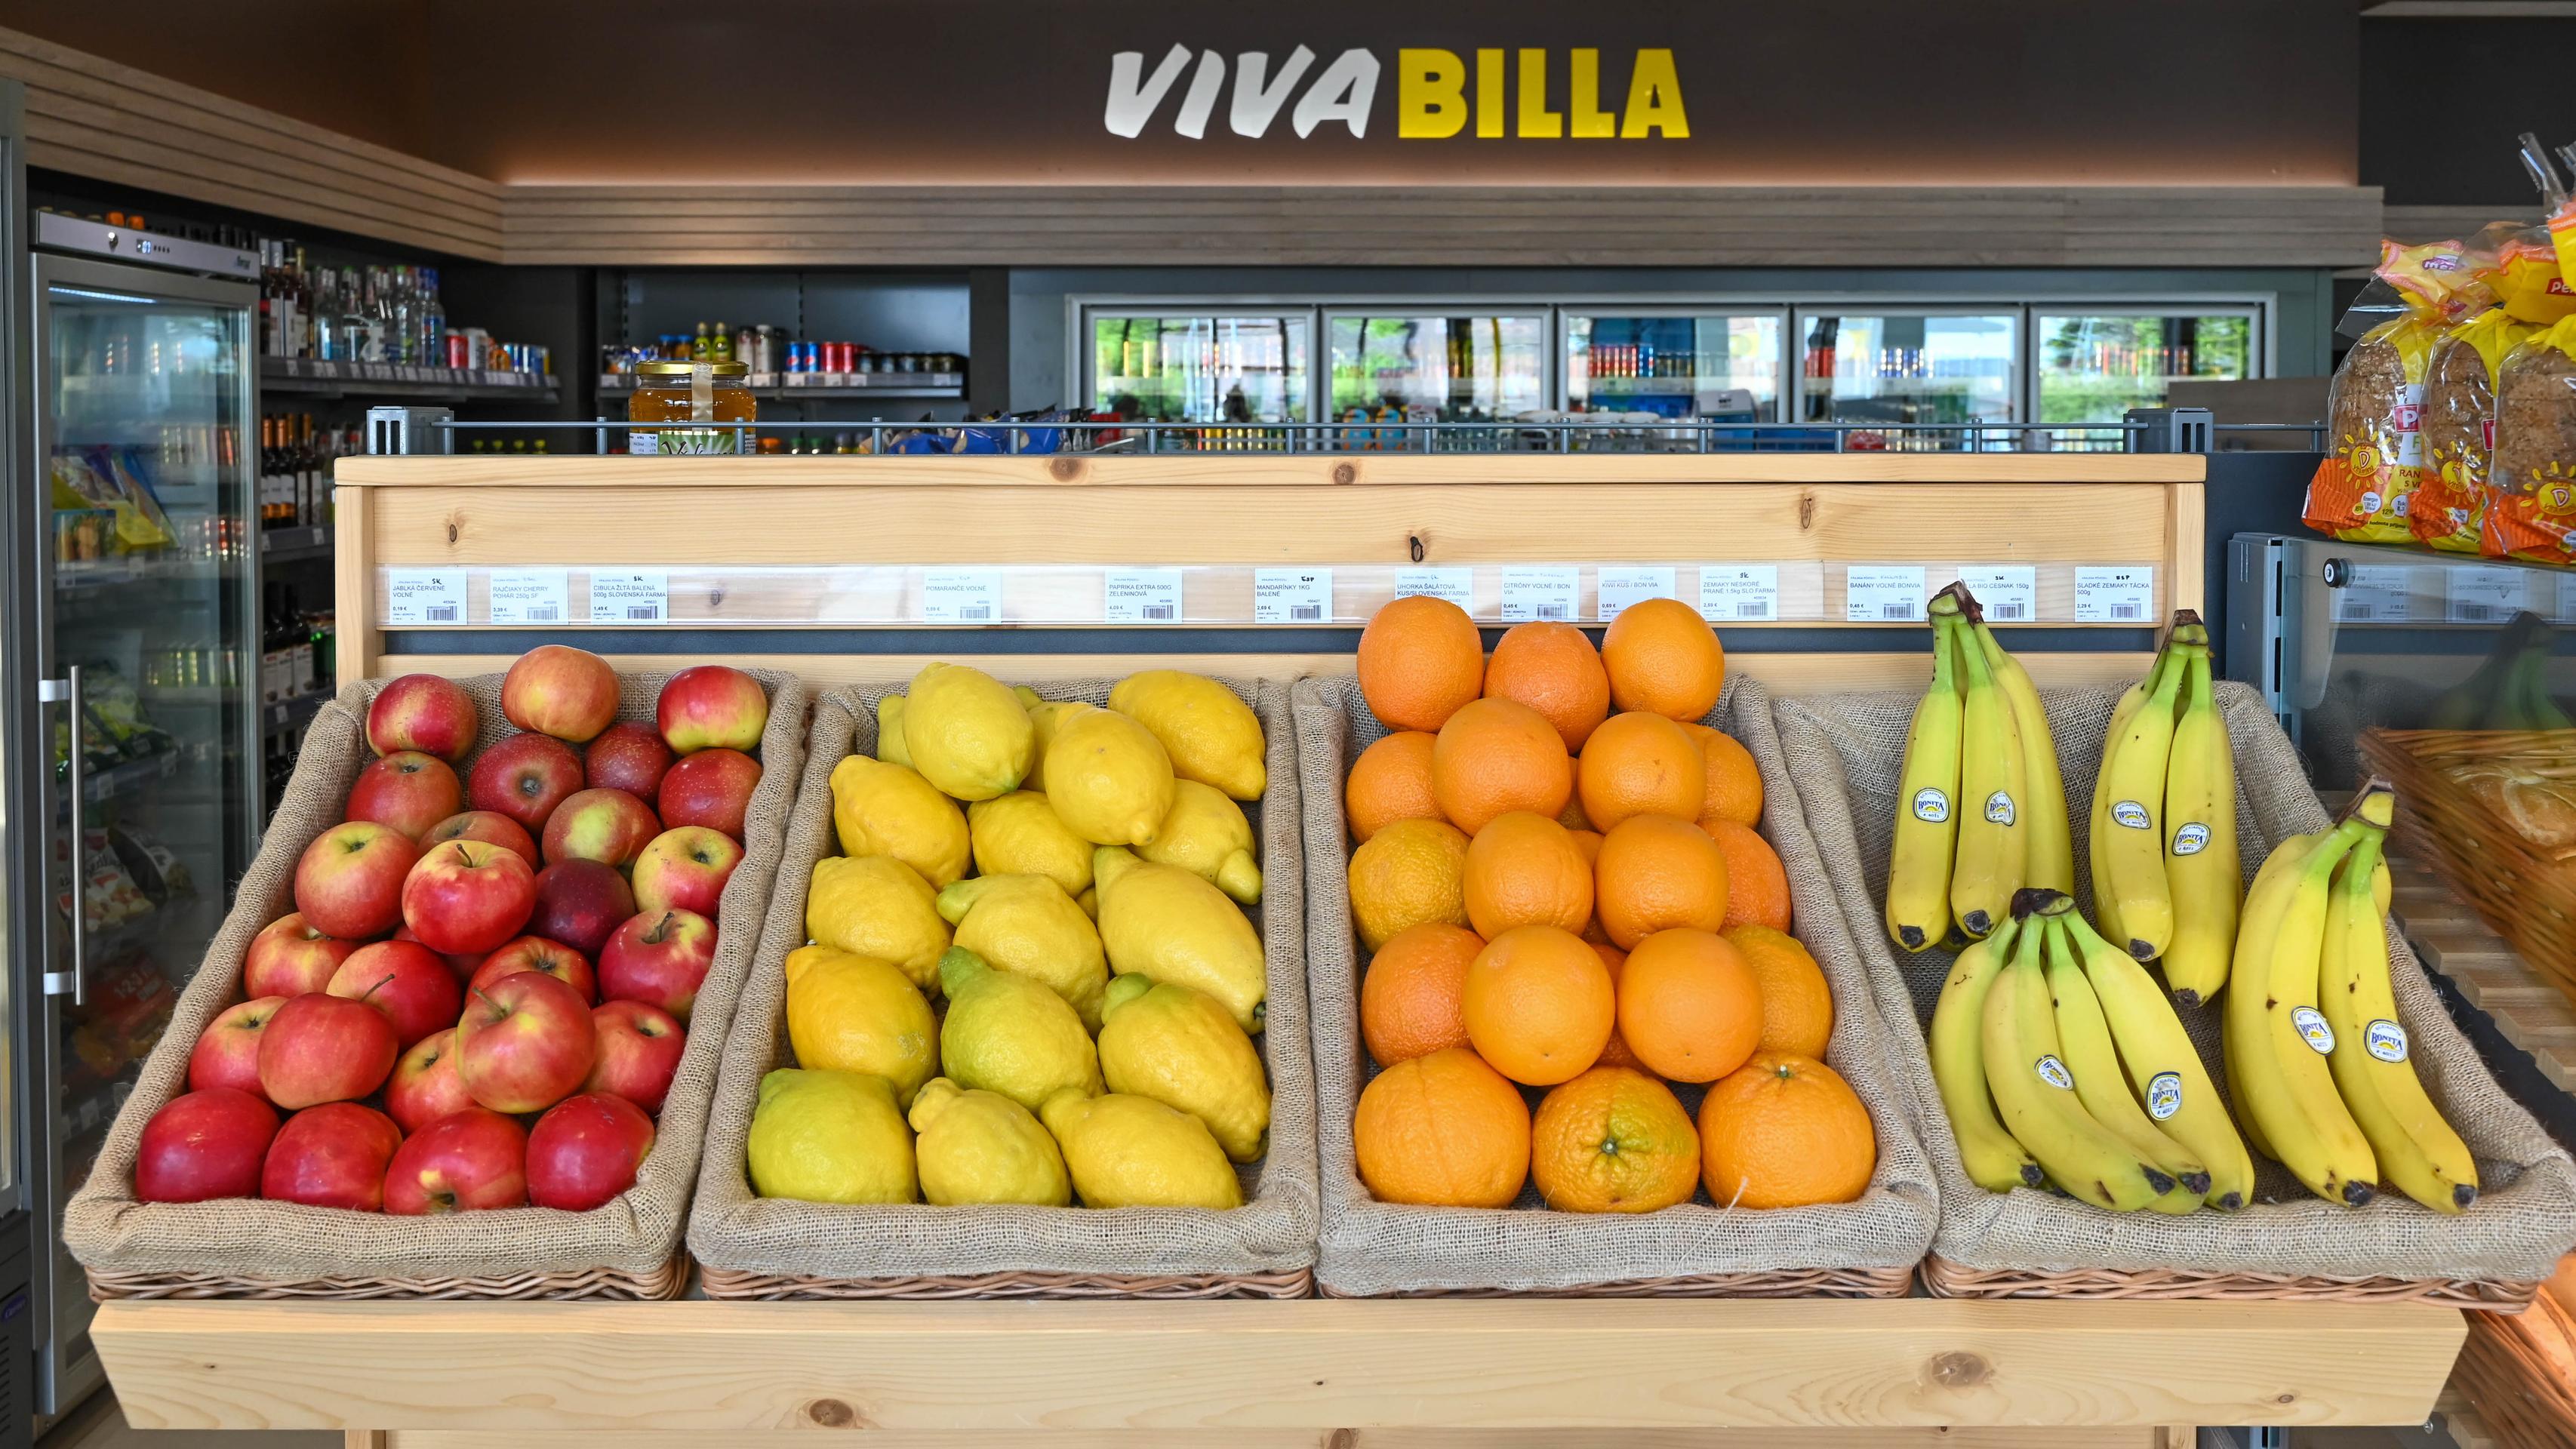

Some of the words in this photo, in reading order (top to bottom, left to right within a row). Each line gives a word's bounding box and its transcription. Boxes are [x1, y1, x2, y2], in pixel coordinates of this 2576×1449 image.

[1104, 42, 1381, 139] VIVA
[1398, 48, 1691, 138] BILLA
[2399, 469, 2421, 478] RAN
[1918, 800, 1945, 811] BONITA
[2117, 811, 2147, 823] BONITA
[2177, 833, 2203, 844] BONITA
[2298, 1023, 2328, 1036] BONITA
[2371, 1032, 2403, 1051] BONITA
[2152, 1089, 2179, 1105] BONITA
